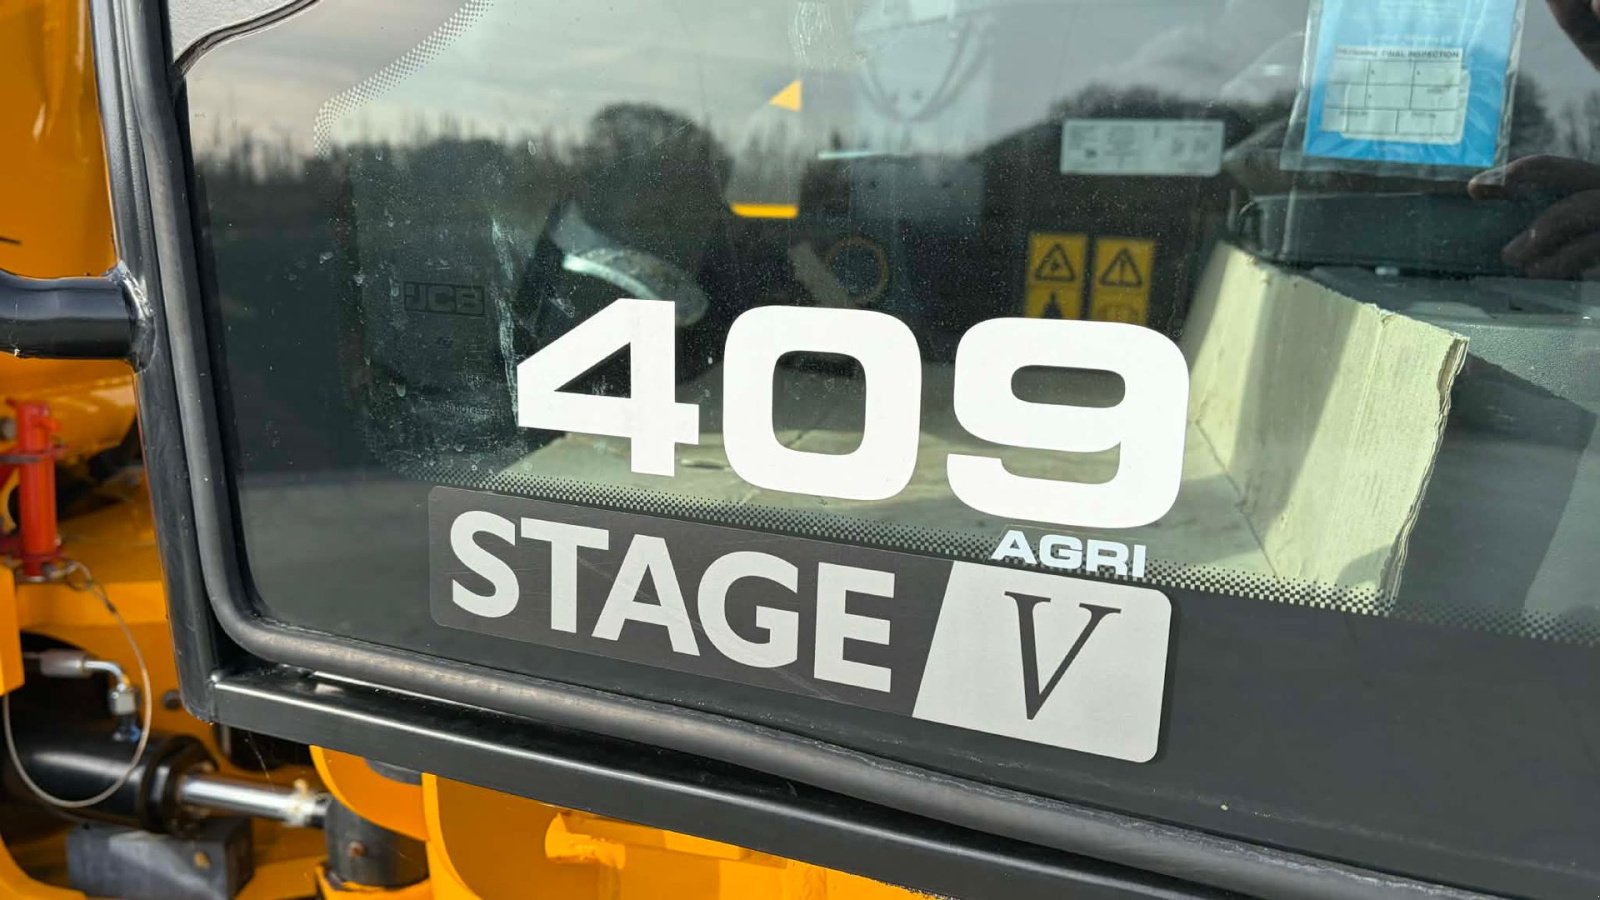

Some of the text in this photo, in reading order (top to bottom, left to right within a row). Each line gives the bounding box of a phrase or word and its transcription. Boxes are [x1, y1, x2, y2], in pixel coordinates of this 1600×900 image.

[404, 282, 484, 316] JCB
[516, 298, 1189, 528] 409
[449, 510, 1121, 721] STAGE V
[991, 529, 1147, 579] AGRI
